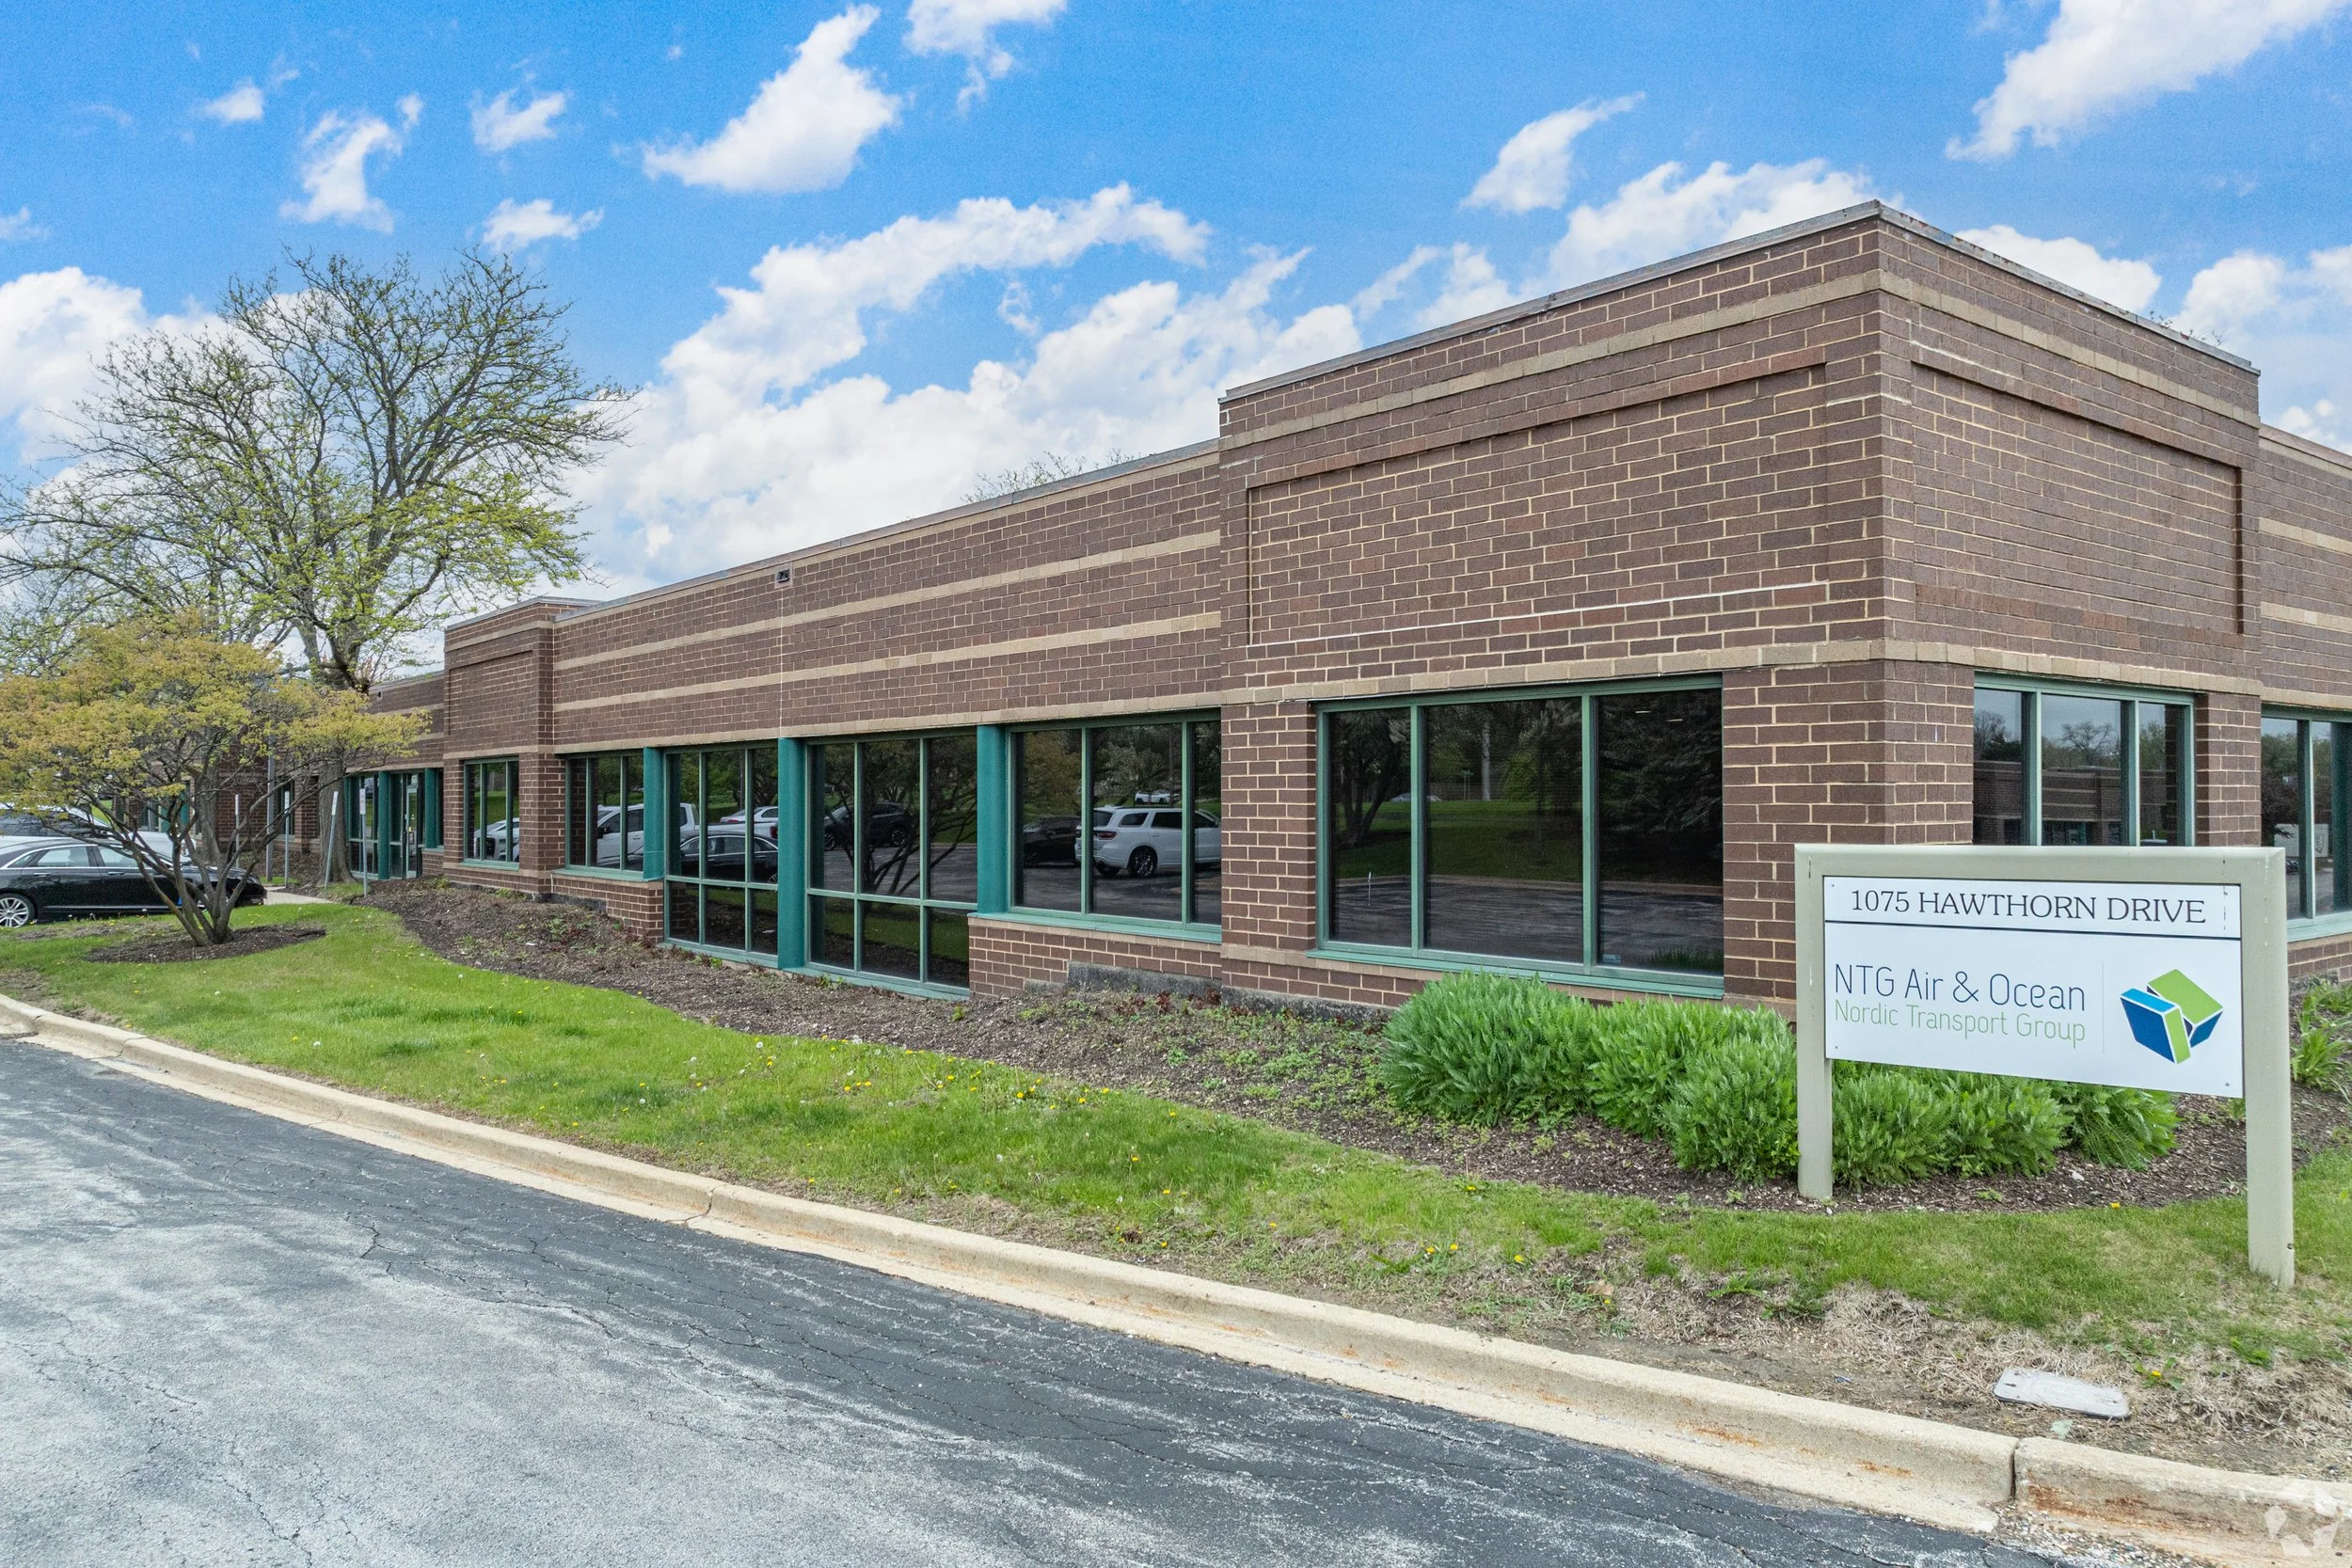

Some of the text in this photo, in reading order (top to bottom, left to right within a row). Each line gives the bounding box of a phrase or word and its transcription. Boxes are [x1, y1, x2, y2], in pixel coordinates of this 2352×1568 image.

[1852, 889, 2206, 924] 1075 HAWTHORN DRIVE
[1836, 963, 2085, 1011] NTG Air & Ocean
[1836, 998, 2086, 1049] Nordic Transport Group
